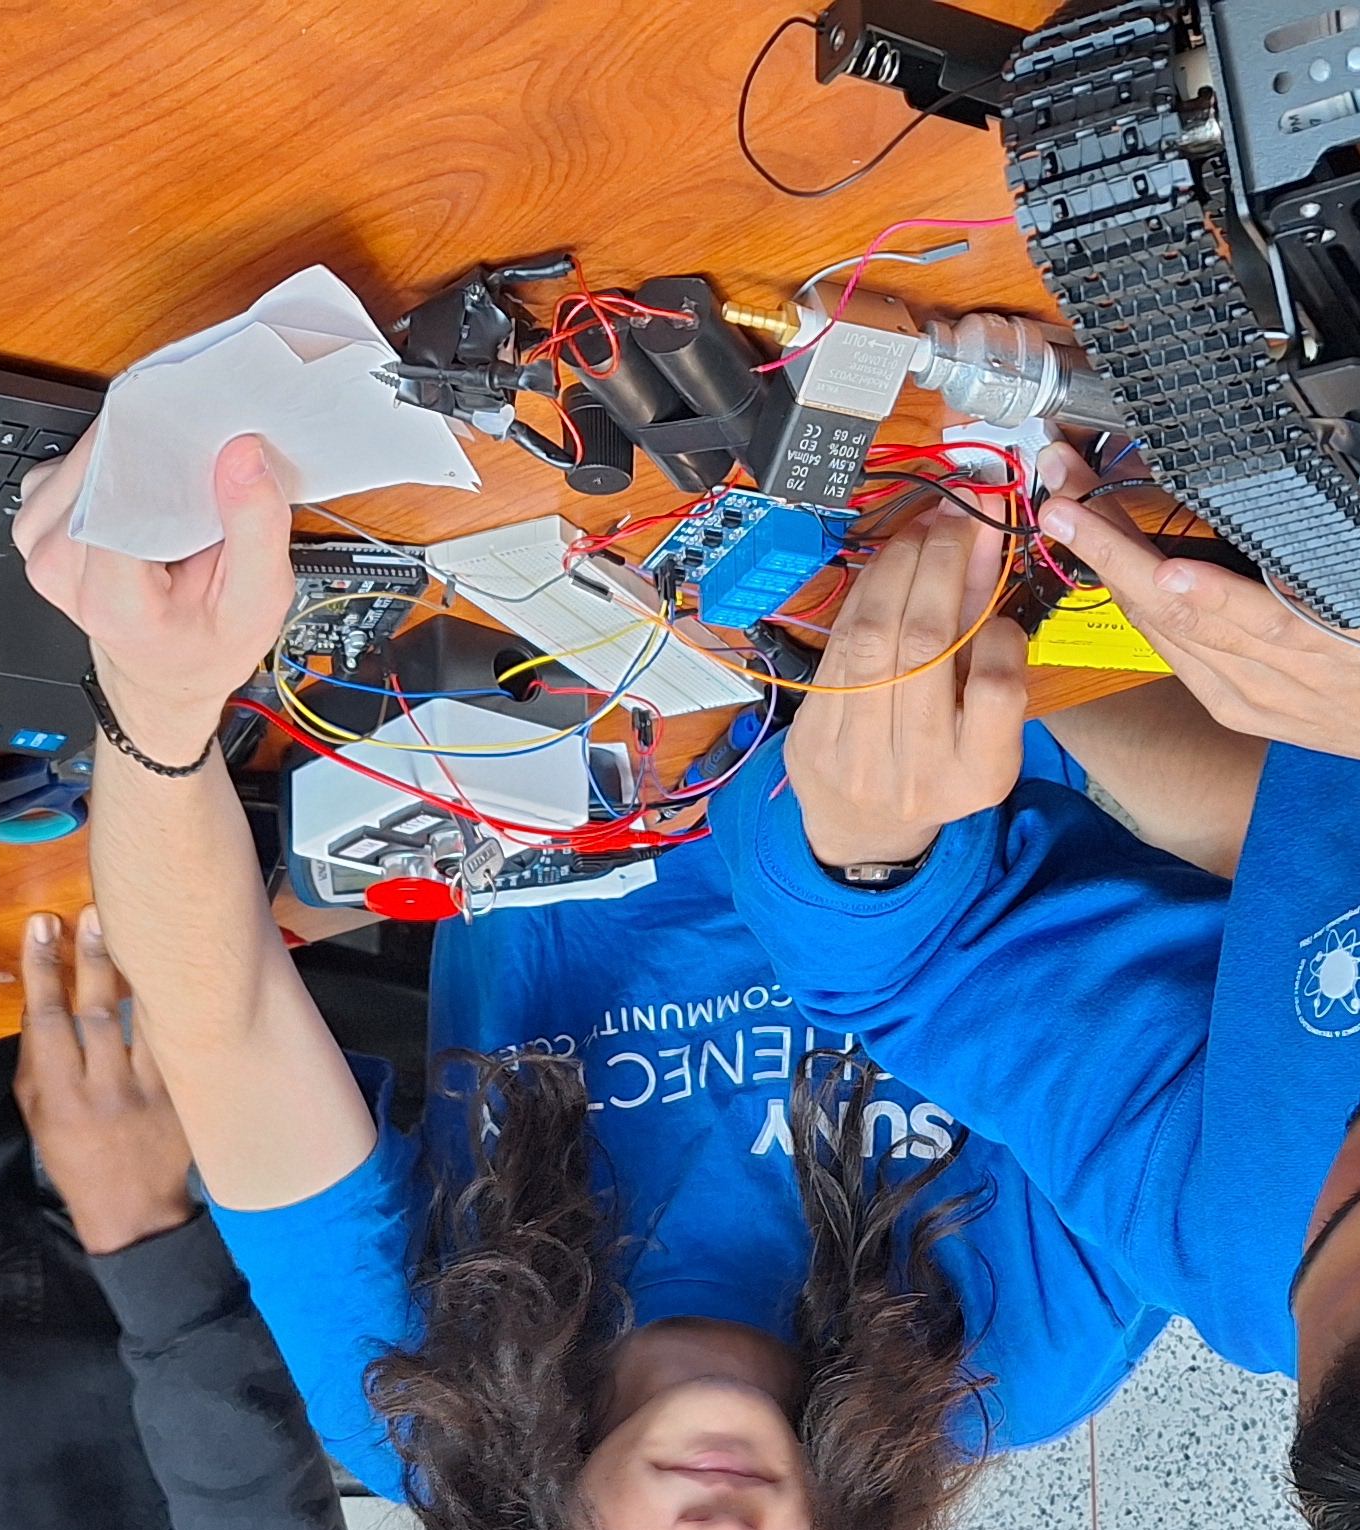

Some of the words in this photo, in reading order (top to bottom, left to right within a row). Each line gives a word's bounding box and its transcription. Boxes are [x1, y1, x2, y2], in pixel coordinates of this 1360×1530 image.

[842, 331, 868, 348] OUT
[886, 341, 906, 358] IN
[852, 351, 899, 370] 0-1.0MPa
[832, 428, 849, 442] 65
[852, 432, 867, 446] IP
[799, 438, 818, 452] ED
[827, 442, 860, 460] 100%
[787, 449, 822, 466] 540mA
[791, 464, 809, 478] DC
[828, 471, 849, 485] 12V
[786, 477, 806, 491] 7/9
[823, 483, 845, 498] EVI
